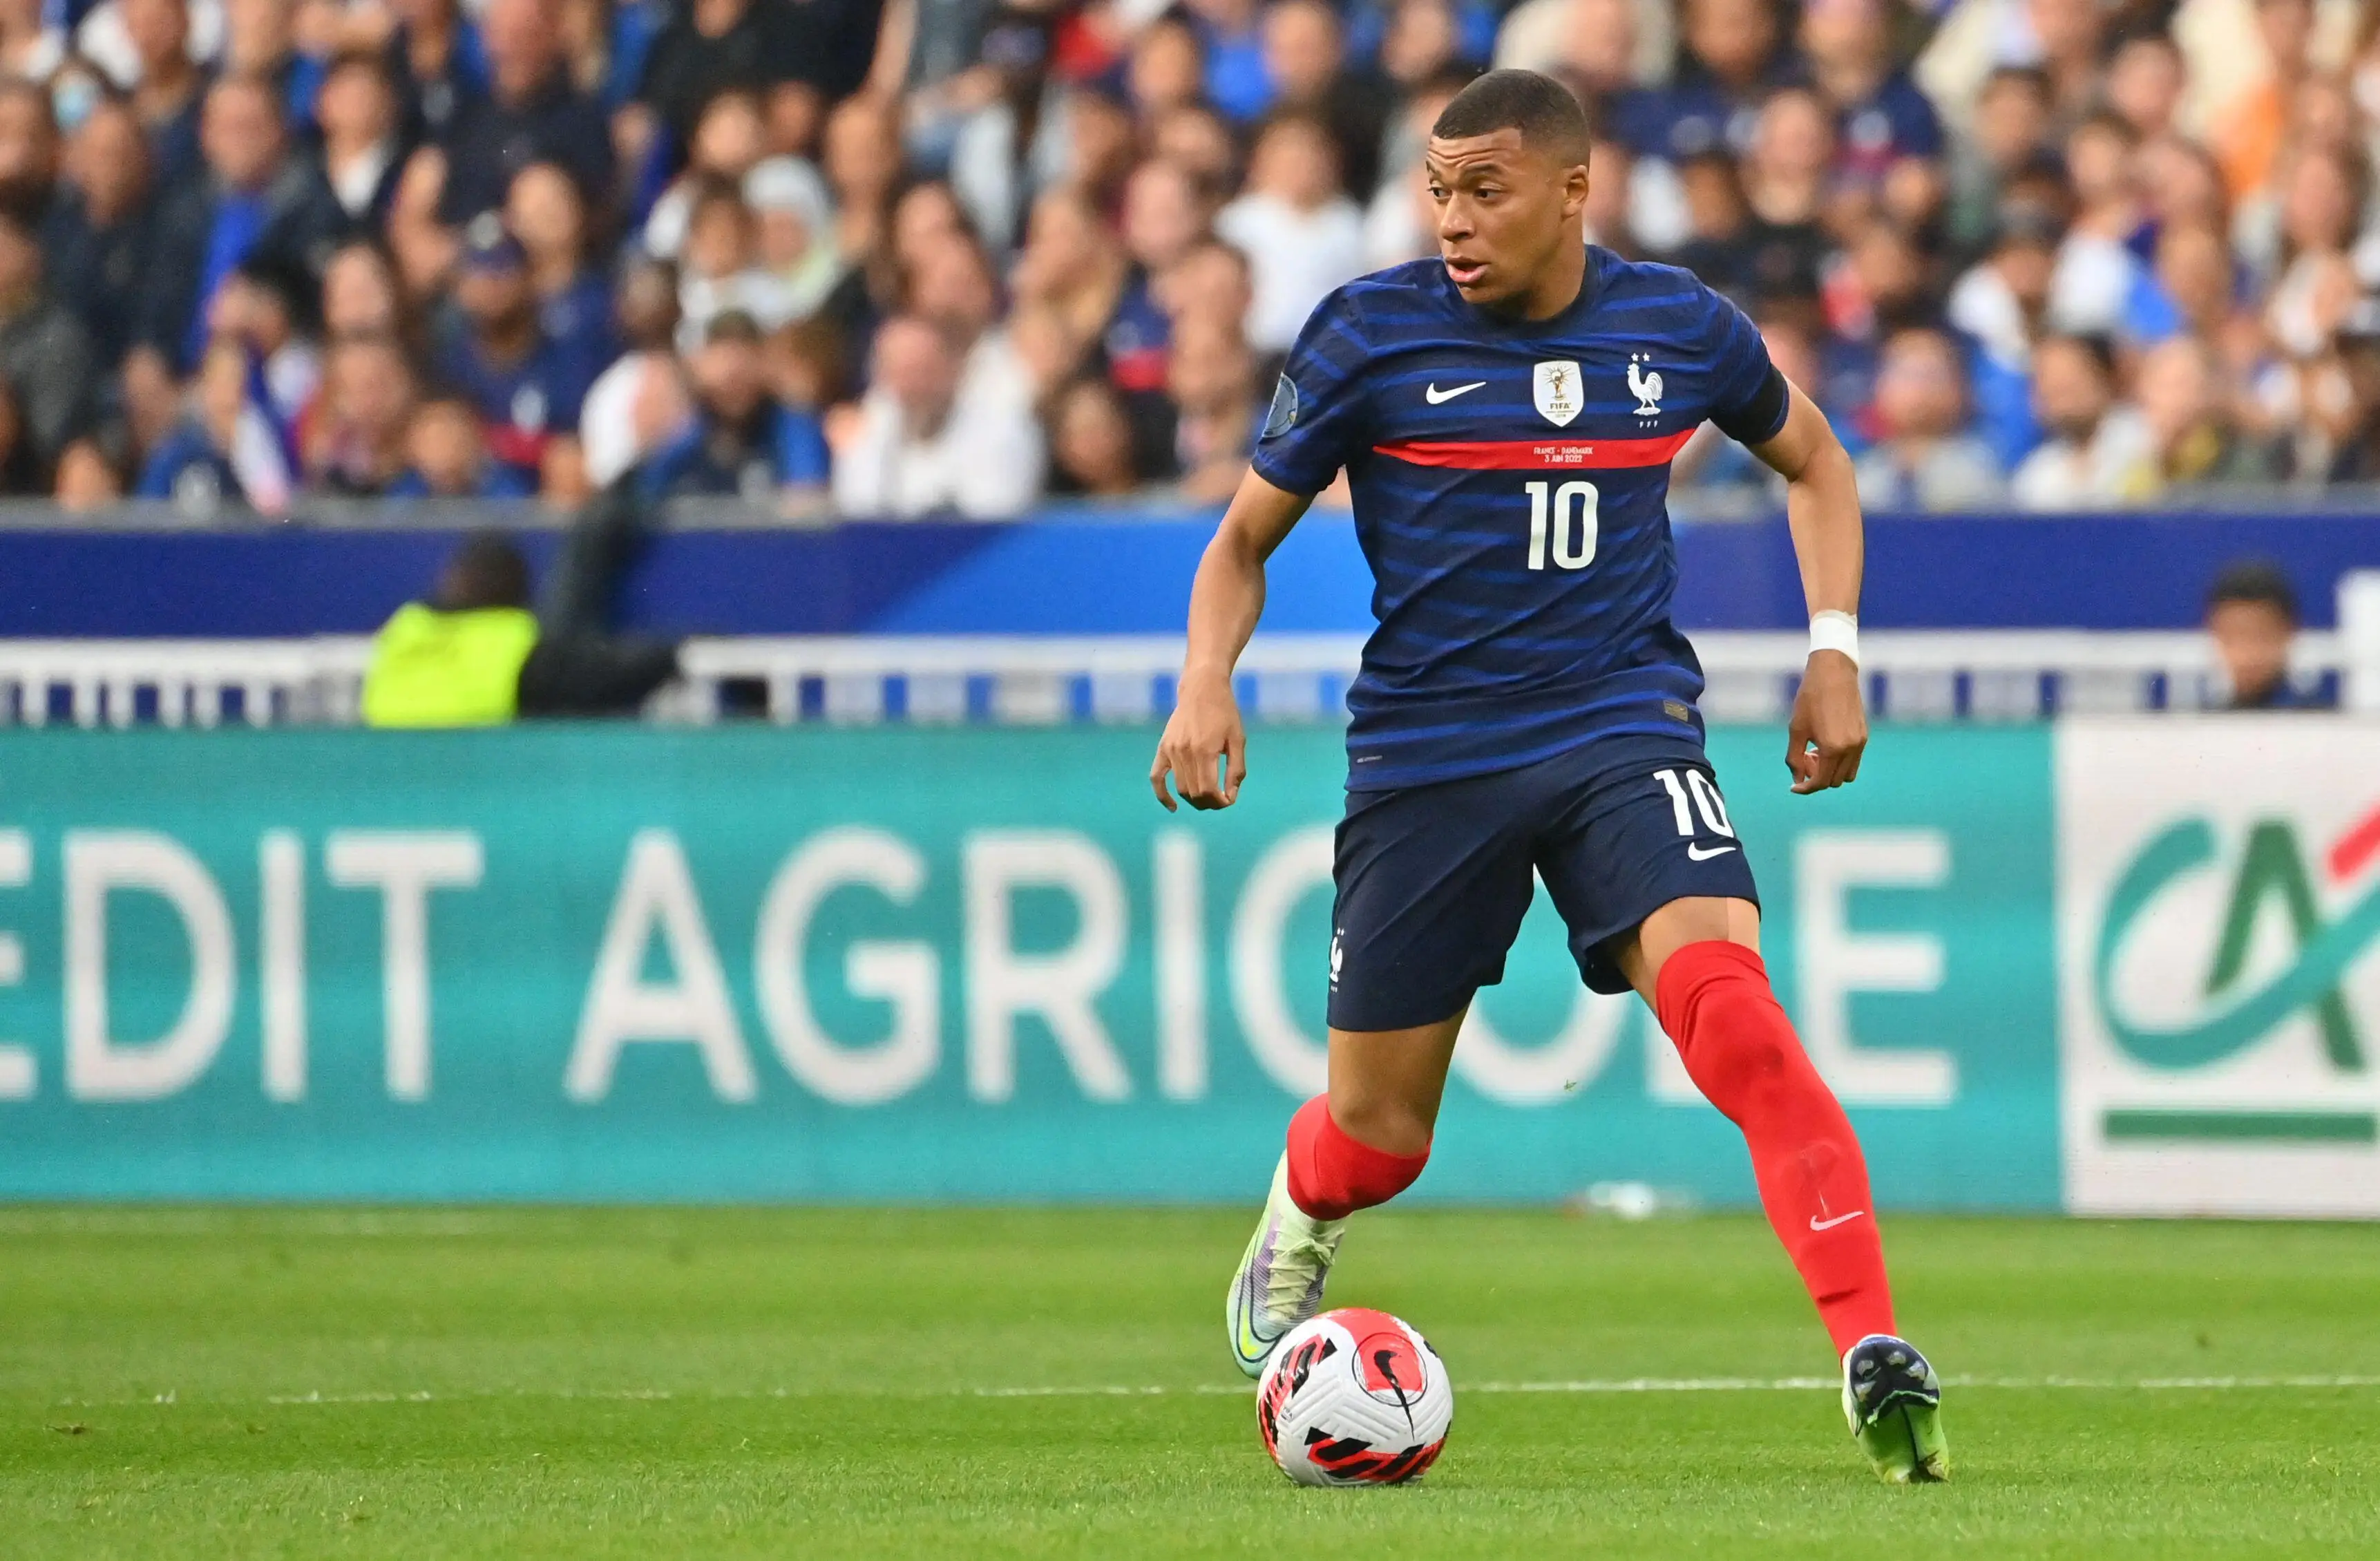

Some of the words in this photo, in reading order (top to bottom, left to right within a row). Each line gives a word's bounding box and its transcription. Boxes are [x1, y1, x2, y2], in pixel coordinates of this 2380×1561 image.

[1534, 446, 1555, 455] FRANCE
[1544, 455, 1550, 463] 3
[1565, 454, 1583, 463] 2022
[1525, 480, 1599, 570] 10
[1653, 769, 1734, 838] 10
